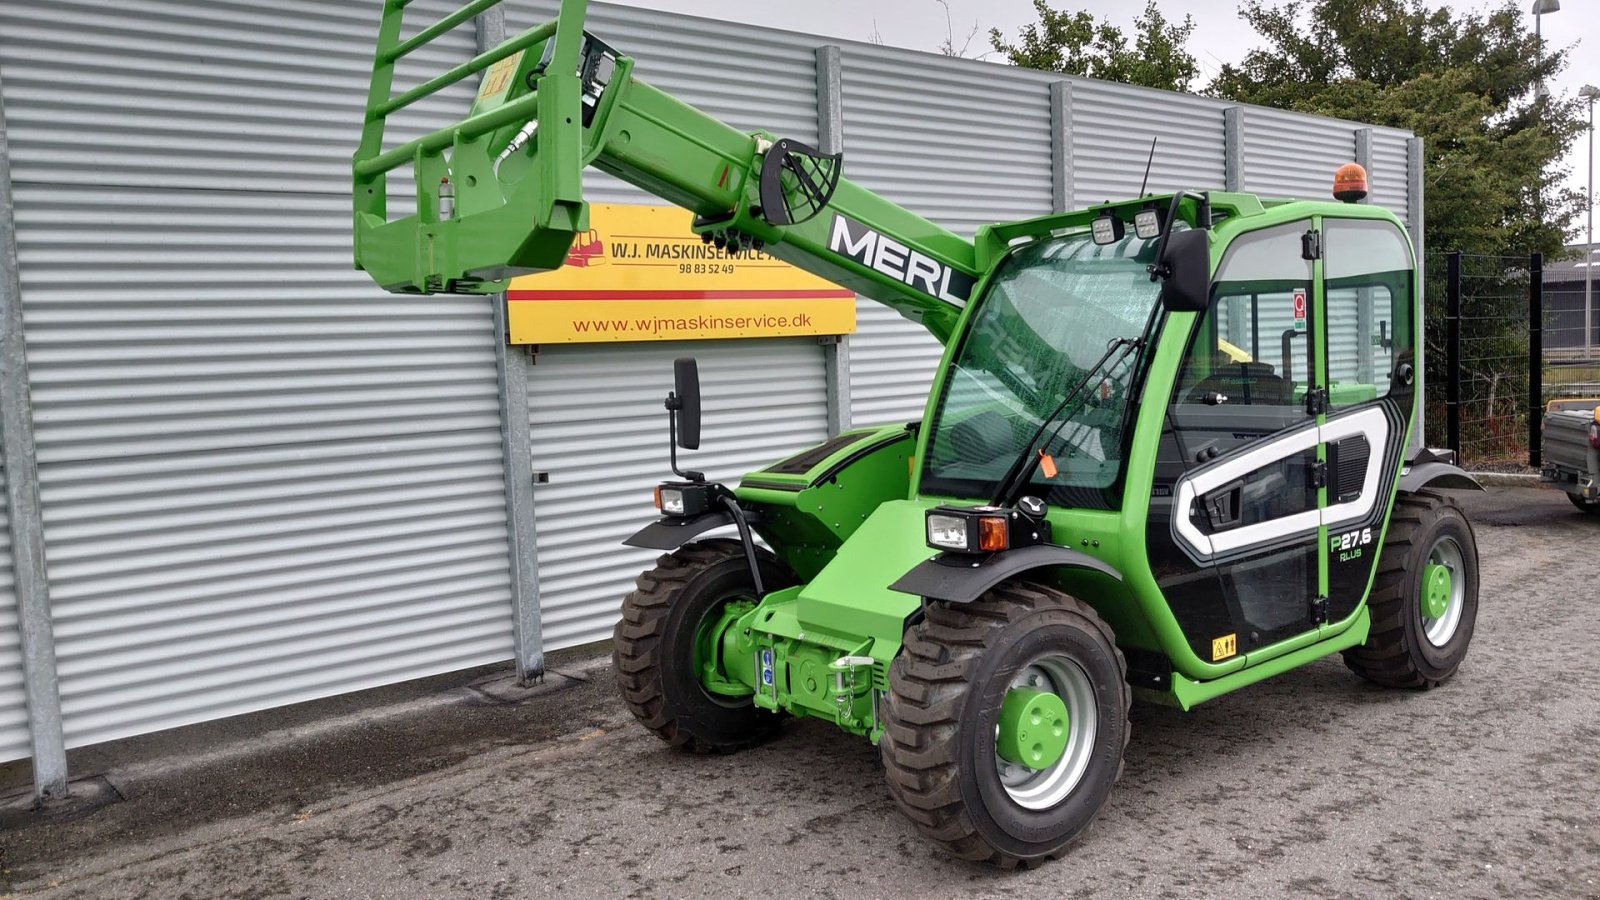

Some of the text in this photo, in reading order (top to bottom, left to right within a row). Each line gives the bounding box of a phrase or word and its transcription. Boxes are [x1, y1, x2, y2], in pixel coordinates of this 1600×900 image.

[611, 242, 642, 258] W.J.
[679, 263, 734, 274] 98 83 52 49
[573, 313, 812, 335] www.wjmaskinservice.dk
